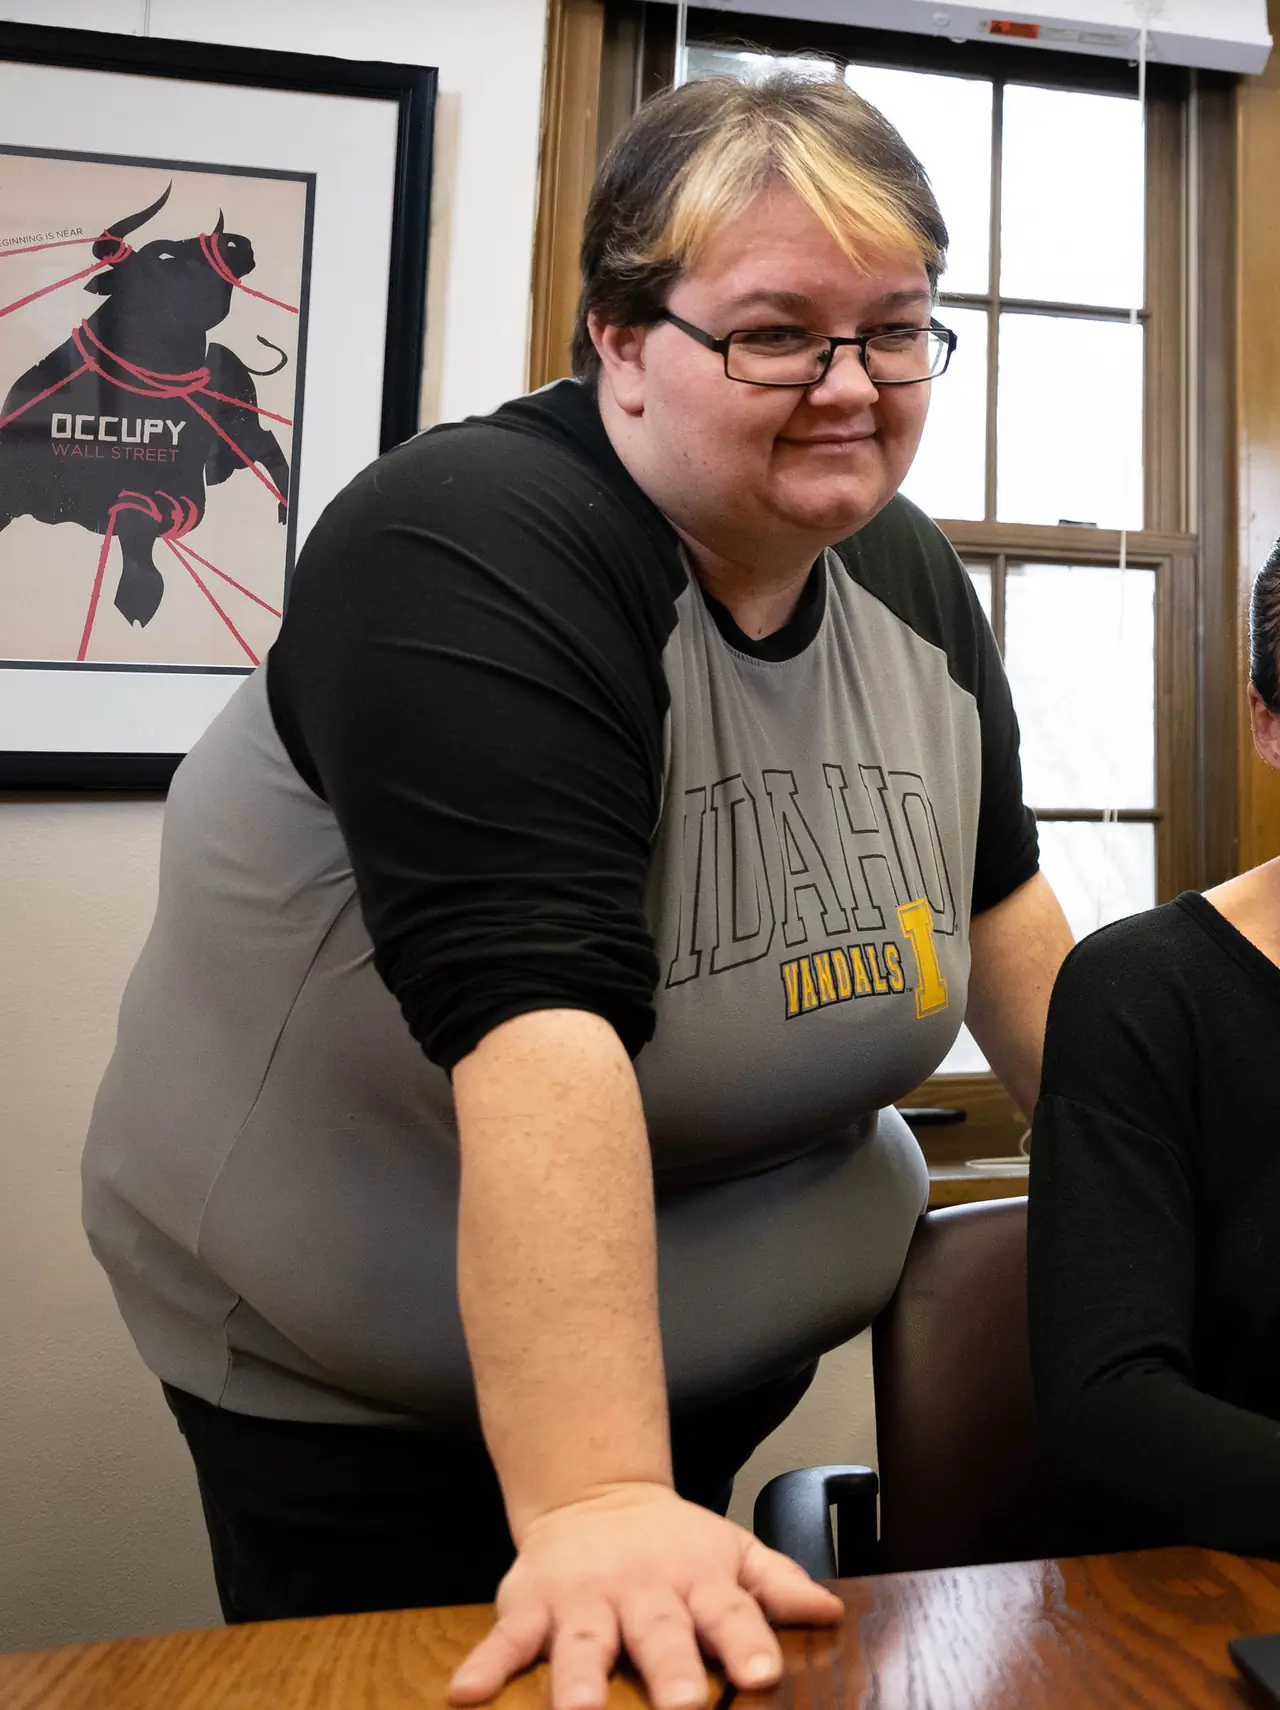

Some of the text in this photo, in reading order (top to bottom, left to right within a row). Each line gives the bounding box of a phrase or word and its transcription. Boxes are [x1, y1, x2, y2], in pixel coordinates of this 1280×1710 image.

[0, 227, 83, 248] GINNING IS NEAR
[51, 412, 187, 446] OCCUPY
[51, 442, 179, 462] WALL STREET
[665, 763, 956, 989] IDAHO
[779, 941, 906, 1020] VANDALS
